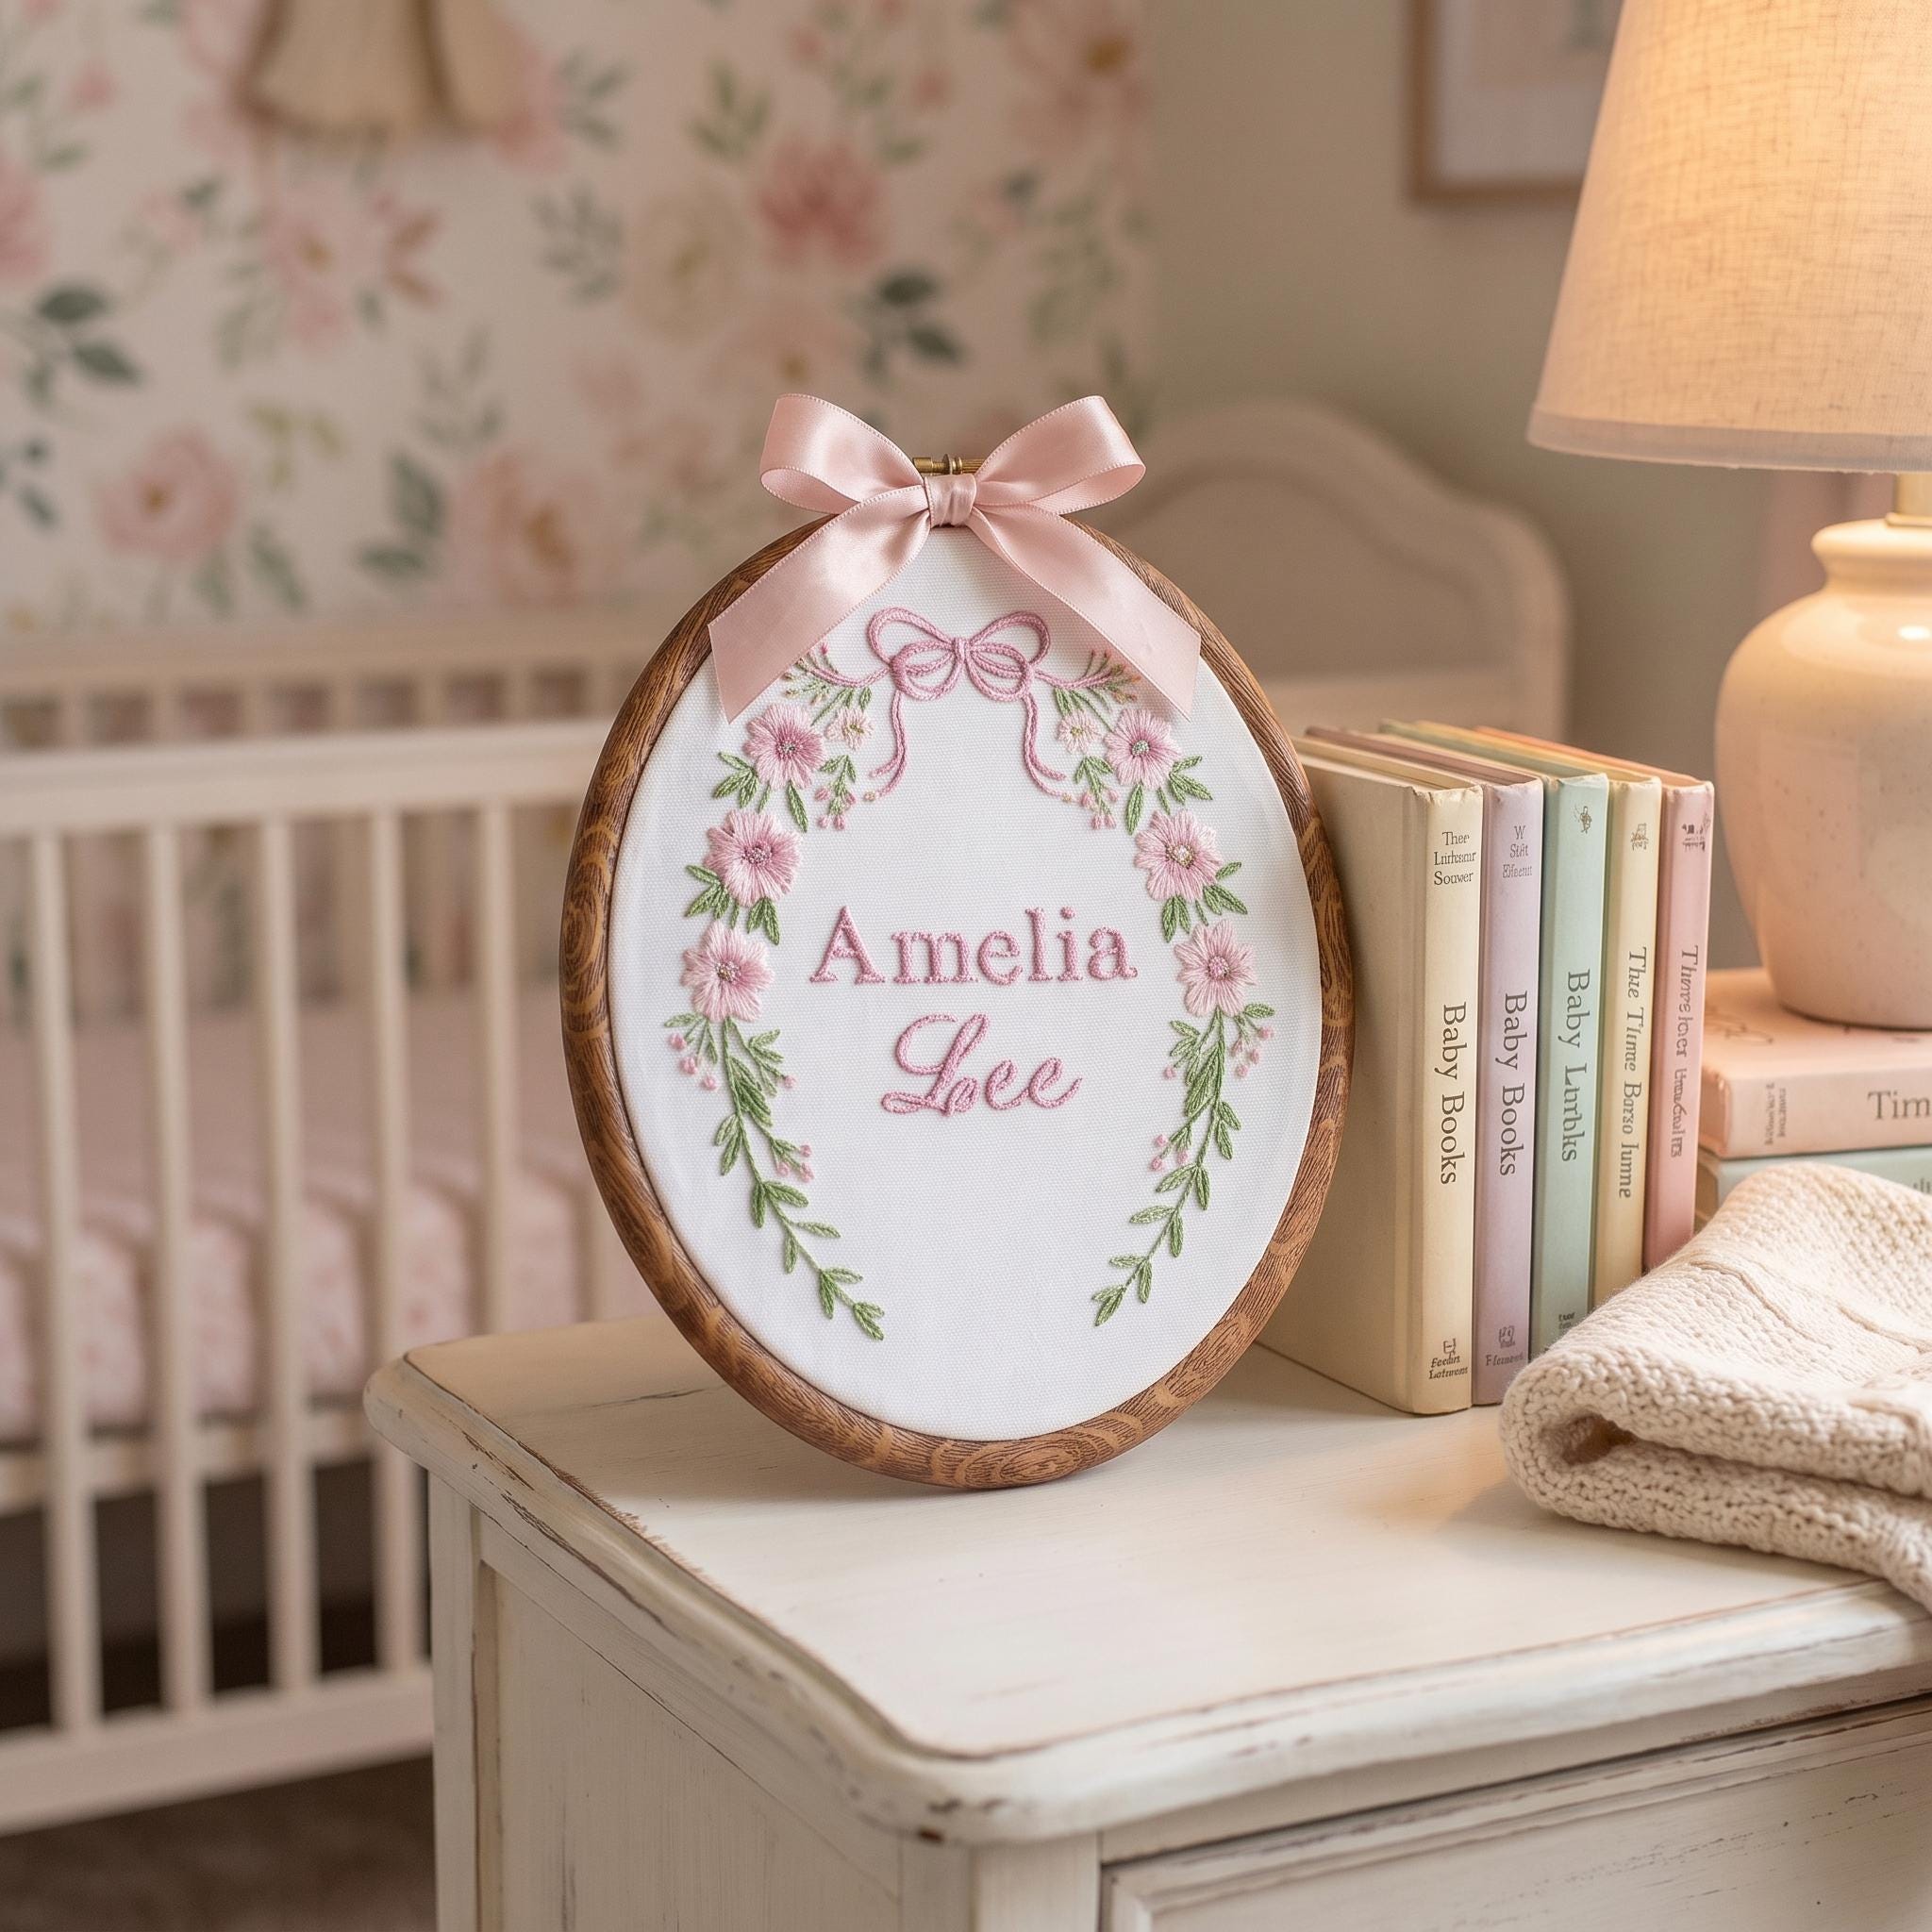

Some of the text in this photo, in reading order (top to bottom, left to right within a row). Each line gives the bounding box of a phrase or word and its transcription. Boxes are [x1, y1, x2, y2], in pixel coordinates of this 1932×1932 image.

[808, 905, 1139, 986] Amelia
[1558, 968, 1591, 1049] Baby
[880, 1011, 1083, 1117] Lee
[1434, 1001, 1468, 1185] Baby Books
[1495, 991, 1528, 1176] Baby Books
